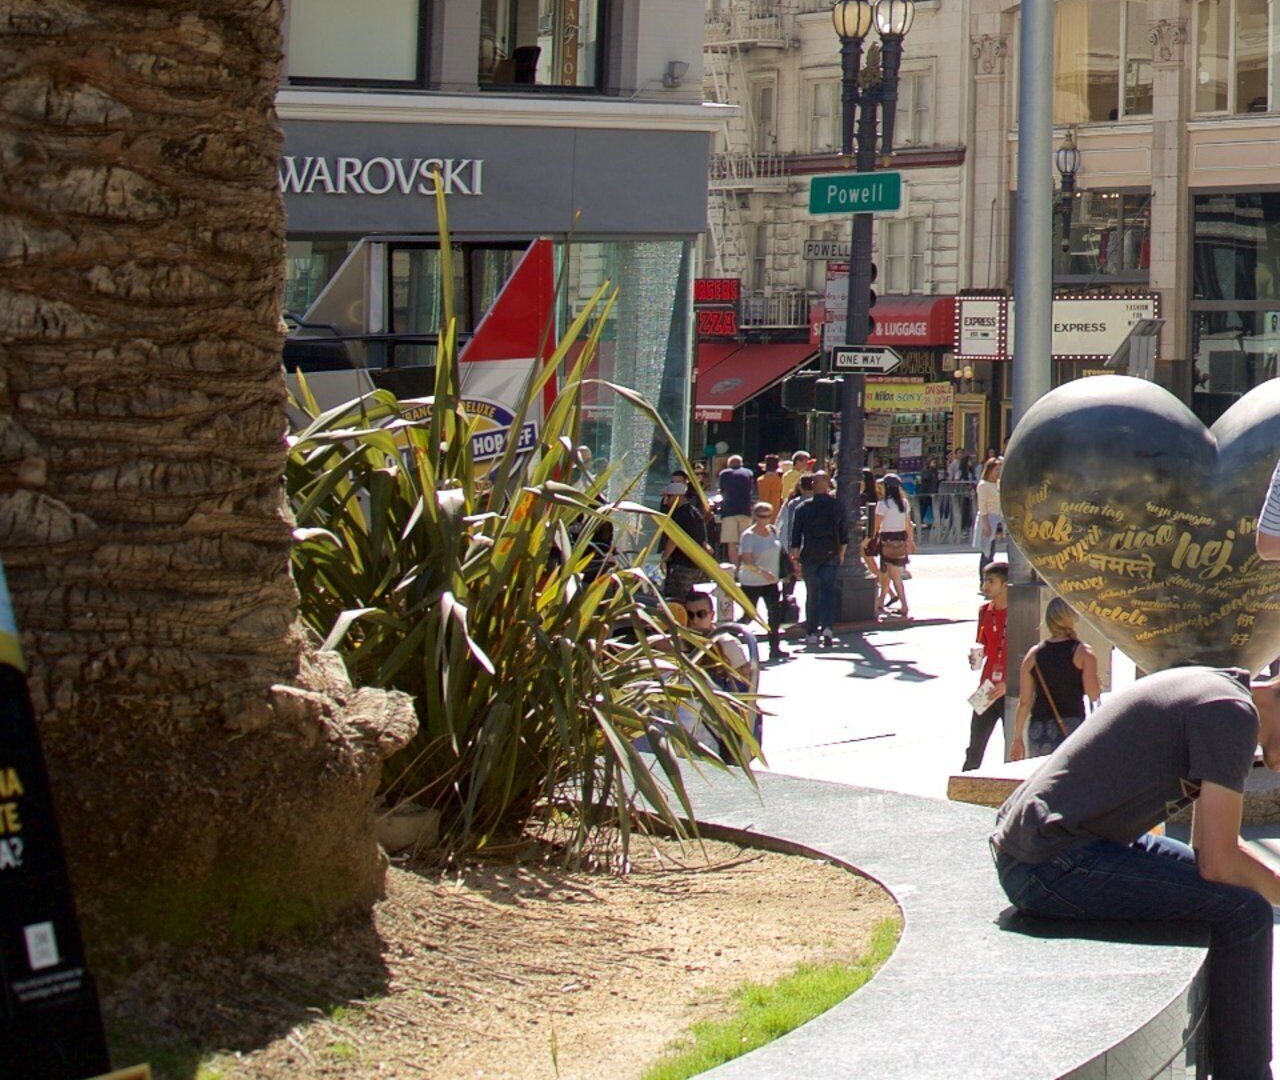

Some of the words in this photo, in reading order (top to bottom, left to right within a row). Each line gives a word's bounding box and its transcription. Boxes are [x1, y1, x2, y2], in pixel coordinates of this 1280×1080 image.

[827, 183, 883, 205] Powell
[807, 243, 851, 257] POWELL
[884, 322, 927, 336] LUGGAGE
[964, 317, 996, 327] EXPRESS
[1054, 322, 1107, 333] EXPRESS
[839, 354, 858, 365] ONE
[862, 354, 882, 365] WAY
[896, 392, 923, 401] SONY
[472, 434, 505, 455] HOP
[1023, 512, 1073, 544] bok
[1109, 524, 1177, 551] ciao
[1171, 529, 1236, 580] hej
